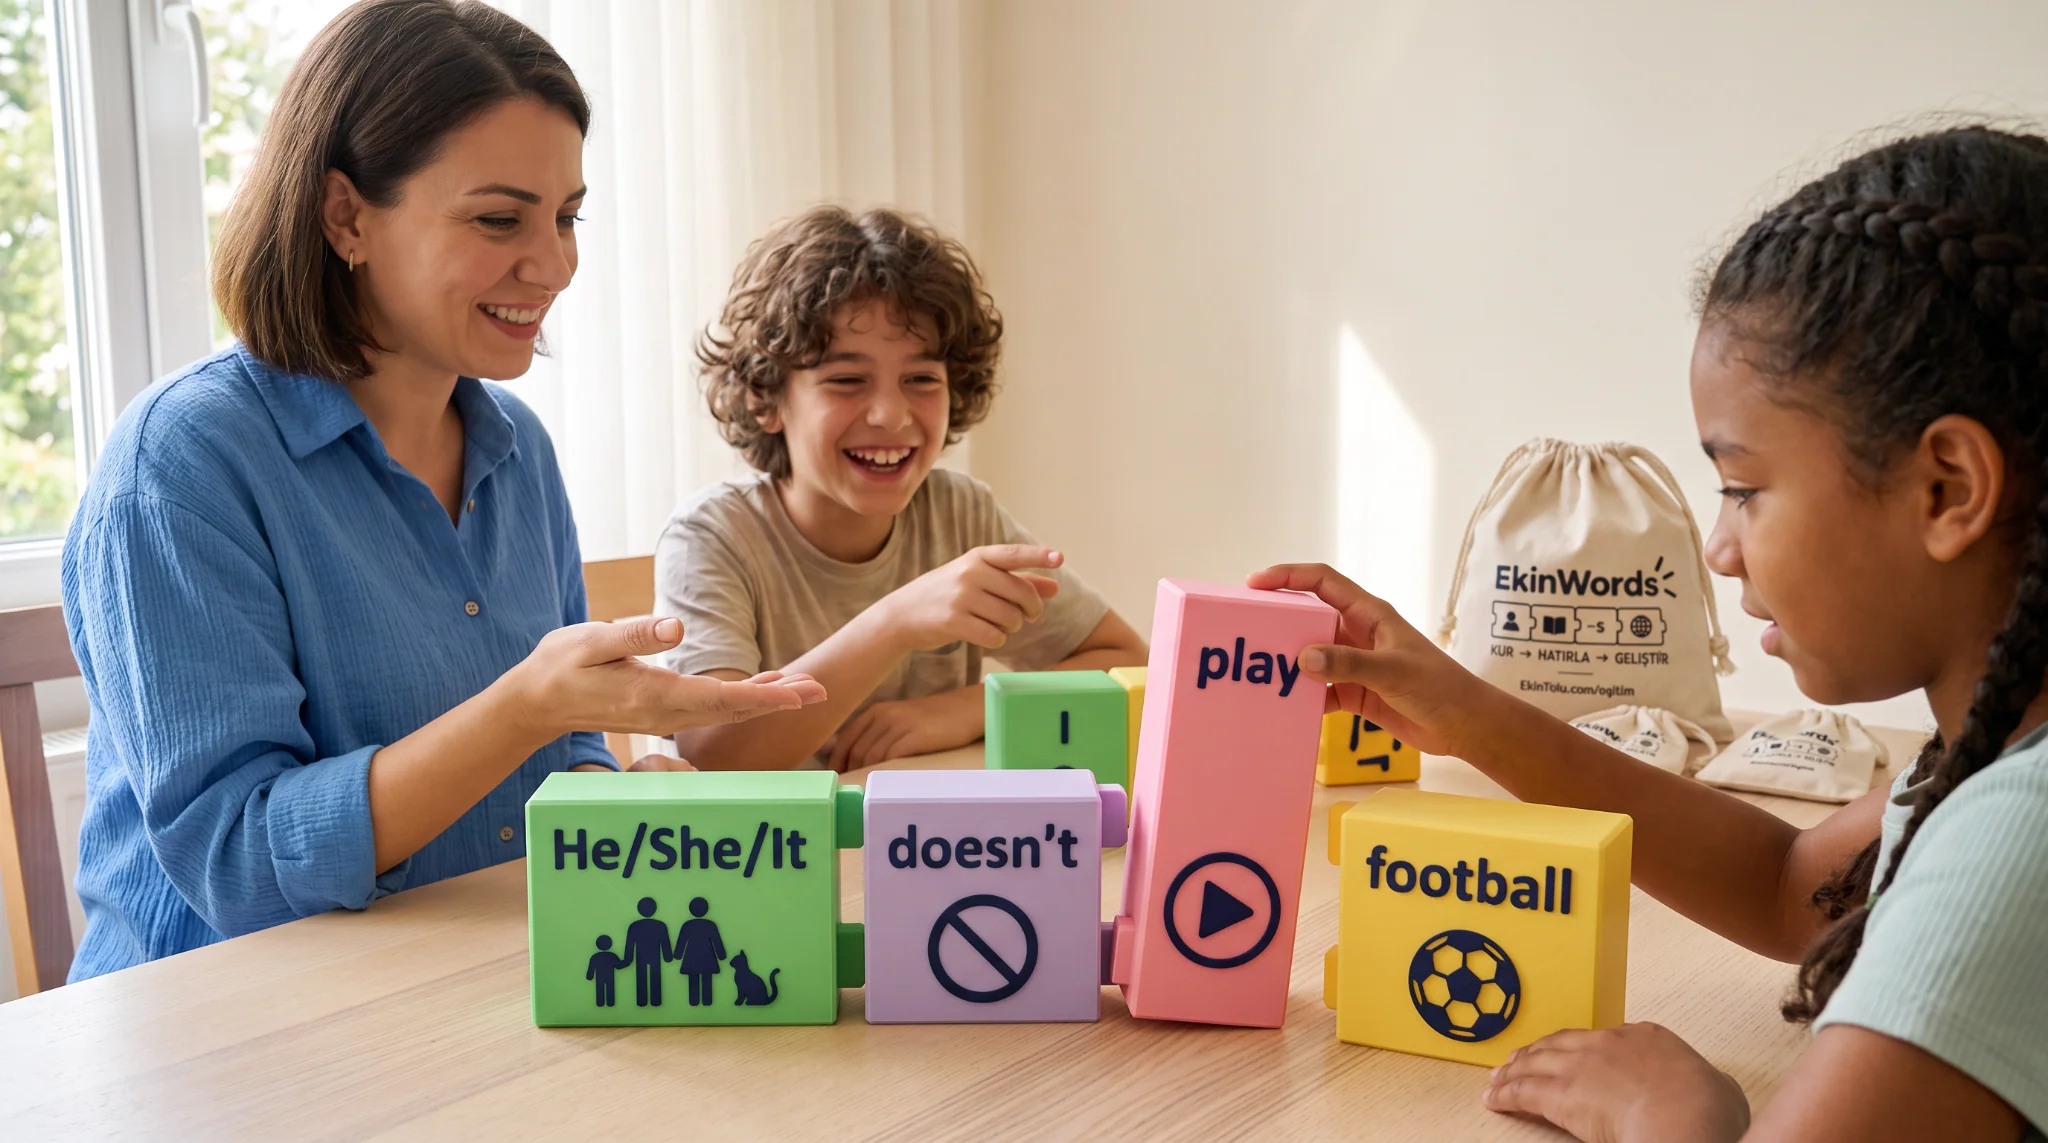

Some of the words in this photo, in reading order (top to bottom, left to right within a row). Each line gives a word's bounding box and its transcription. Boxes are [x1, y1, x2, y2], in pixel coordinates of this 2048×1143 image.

[1495, 564, 1659, 597] EkinWords
[1197, 637, 1301, 697] play
[1490, 643, 1515, 658] KUR
[1537, 648, 1591, 664] HATIRLA
[553, 821, 807, 879] He/She/It
[1366, 844, 1573, 915] football
